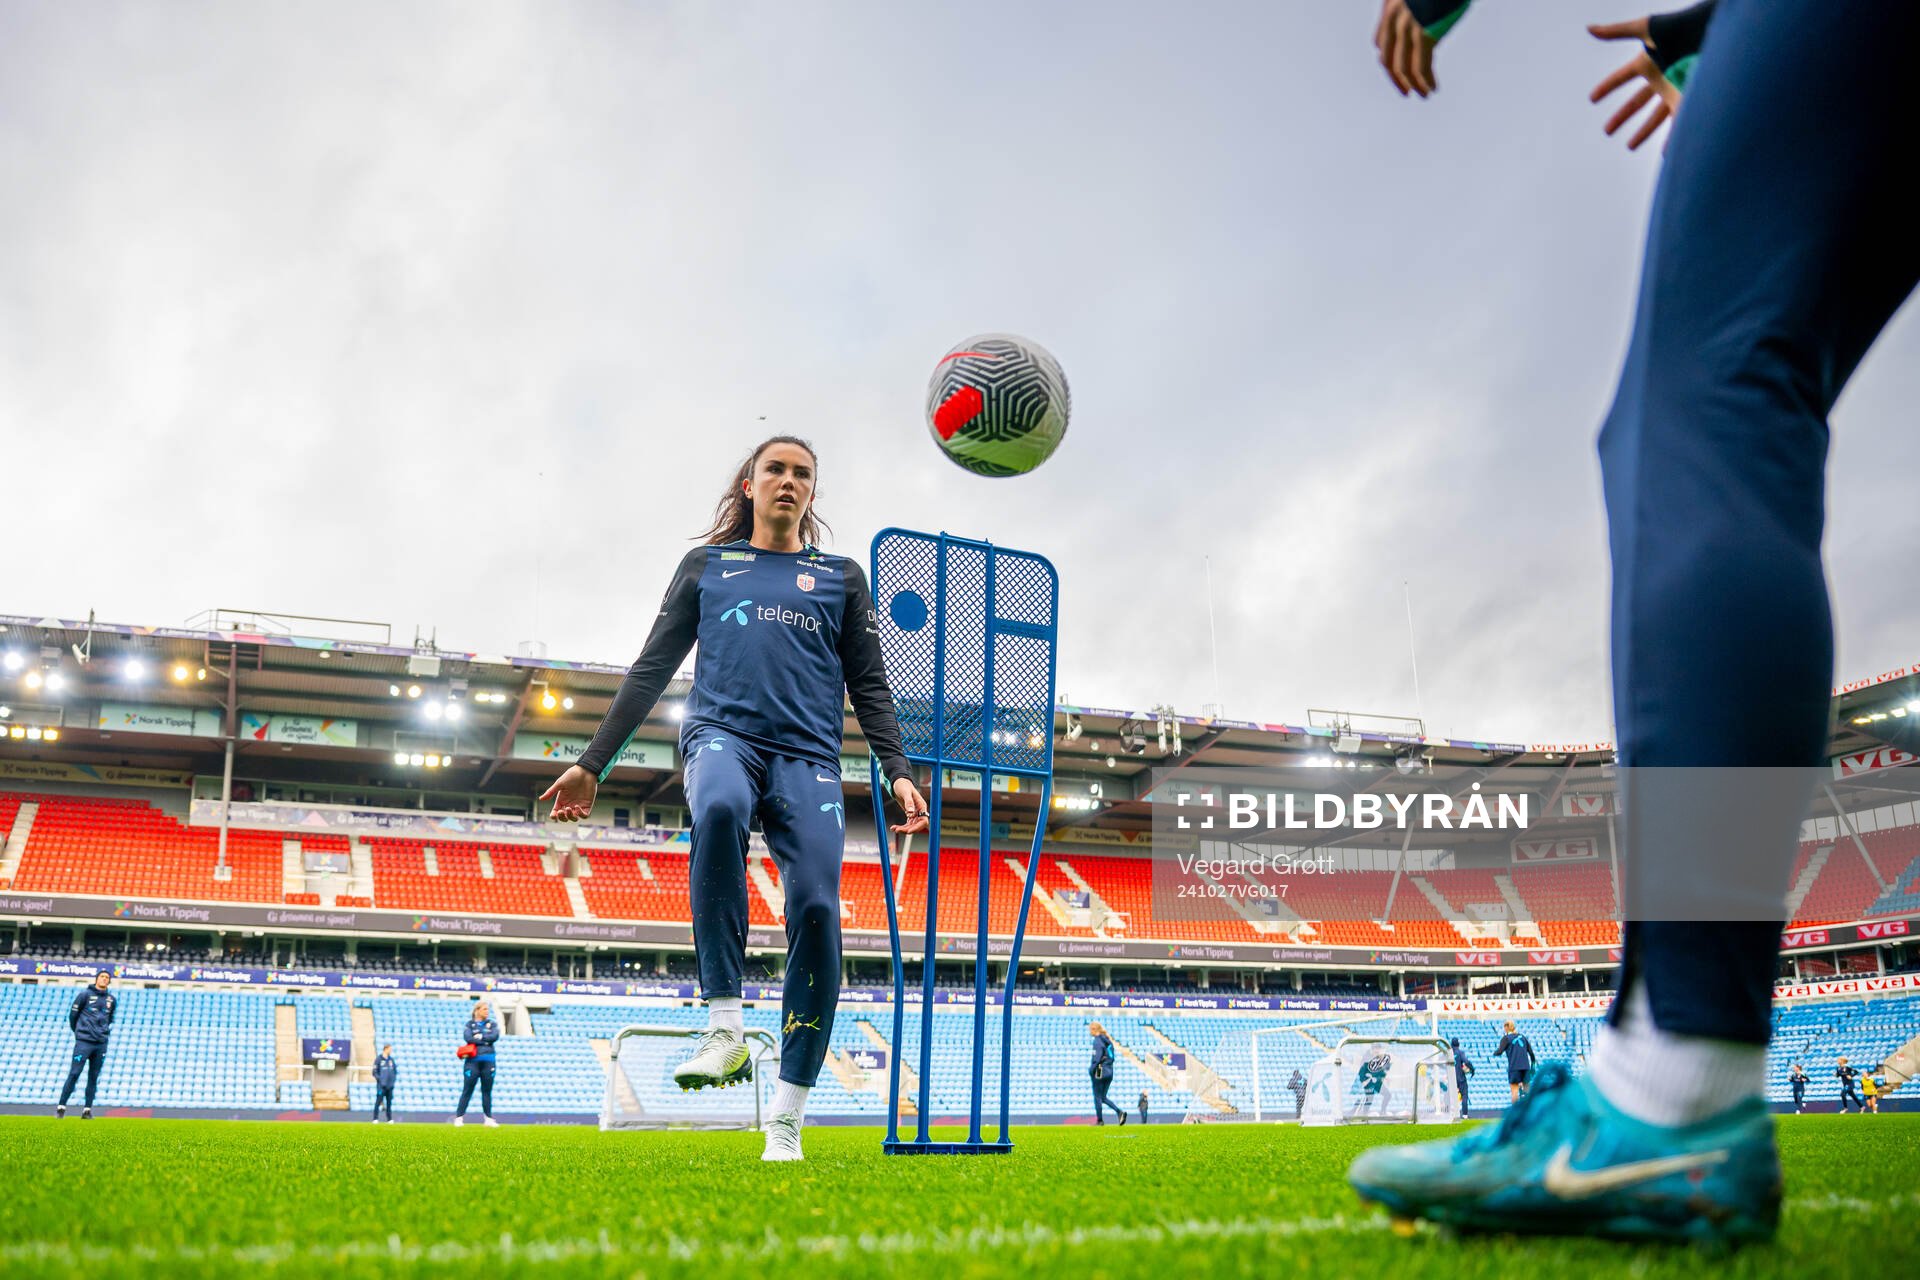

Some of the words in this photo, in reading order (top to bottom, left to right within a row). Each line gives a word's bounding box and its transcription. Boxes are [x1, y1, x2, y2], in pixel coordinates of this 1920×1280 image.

[797, 559, 813, 568] Norsk
[813, 562, 834, 573] Tipping
[757, 604, 822, 635] telenor
[139, 715, 162, 726] Norsk
[163, 717, 196, 729] Tipping
[1841, 748, 1916, 774] VG
[1518, 840, 1591, 860] VG
[134, 905, 167, 917] Norsk
[169, 906, 209, 921] Tipping
[431, 918, 462, 930] Norsk
[463, 920, 501, 934] Tipping
[1859, 921, 1905, 938] VG
[956, 939, 977, 950] Nors
[988, 941, 1013, 953] ipping
[1781, 931, 1826, 947] VG
[1181, 946, 1205, 957] Norsk
[1206, 948, 1234, 959] Tipping
[1382, 952, 1402, 962] Norsk
[1403, 953, 1429, 964] Tipping
[1457, 953, 1498, 965] VG
[1530, 950, 1577, 963] VG
